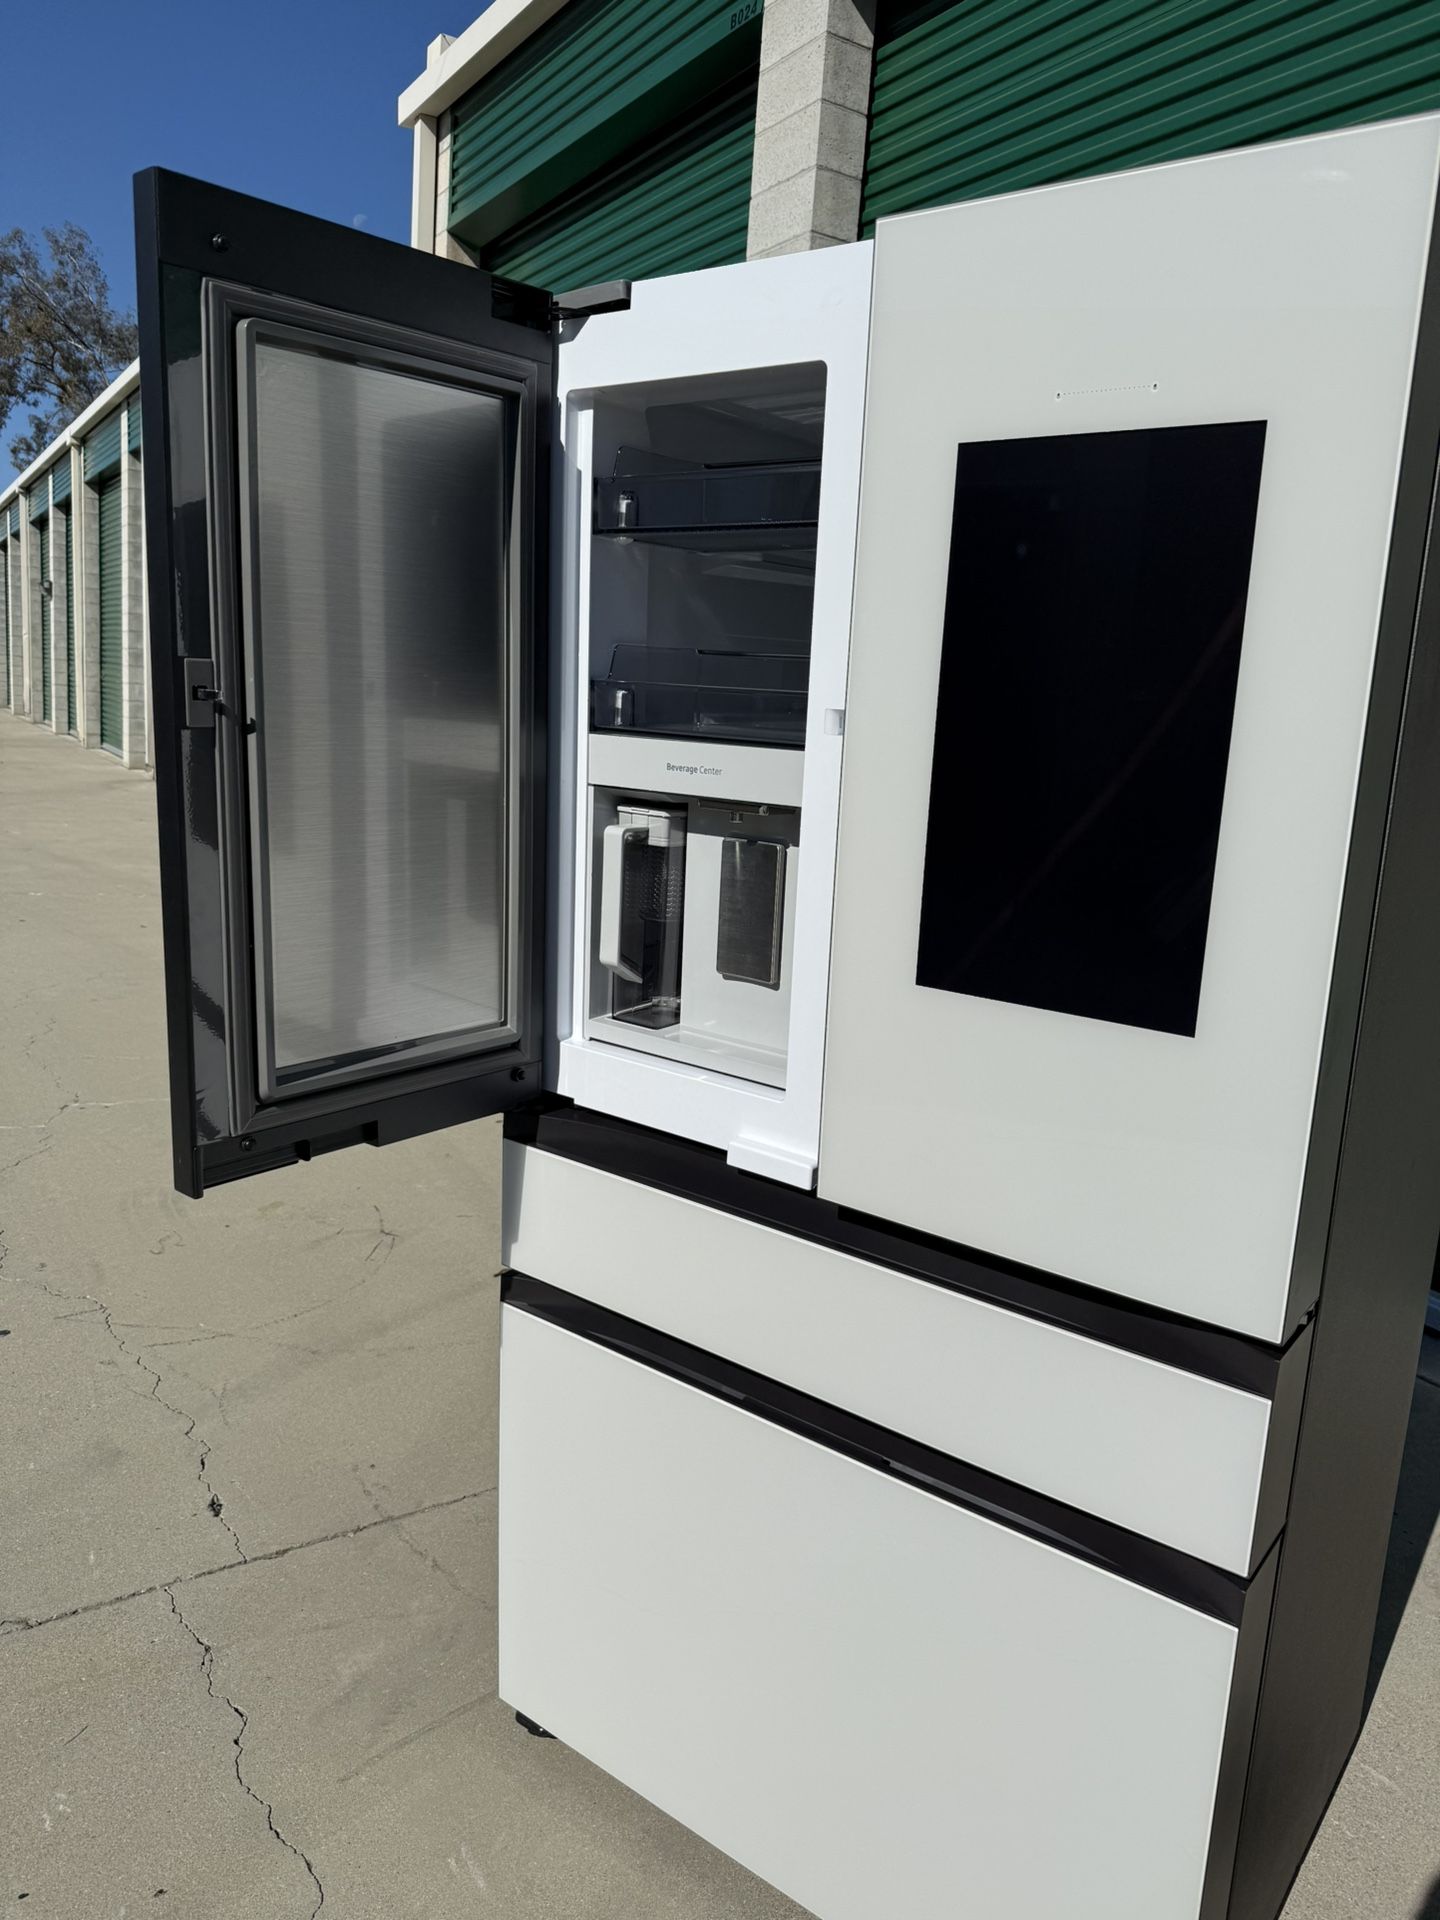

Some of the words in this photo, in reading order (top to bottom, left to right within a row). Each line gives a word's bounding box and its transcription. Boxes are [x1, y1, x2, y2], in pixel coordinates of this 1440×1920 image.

[730, 1, 758, 30] B024
[666, 762, 698, 775] Beverage
[699, 765, 722, 776] Center
